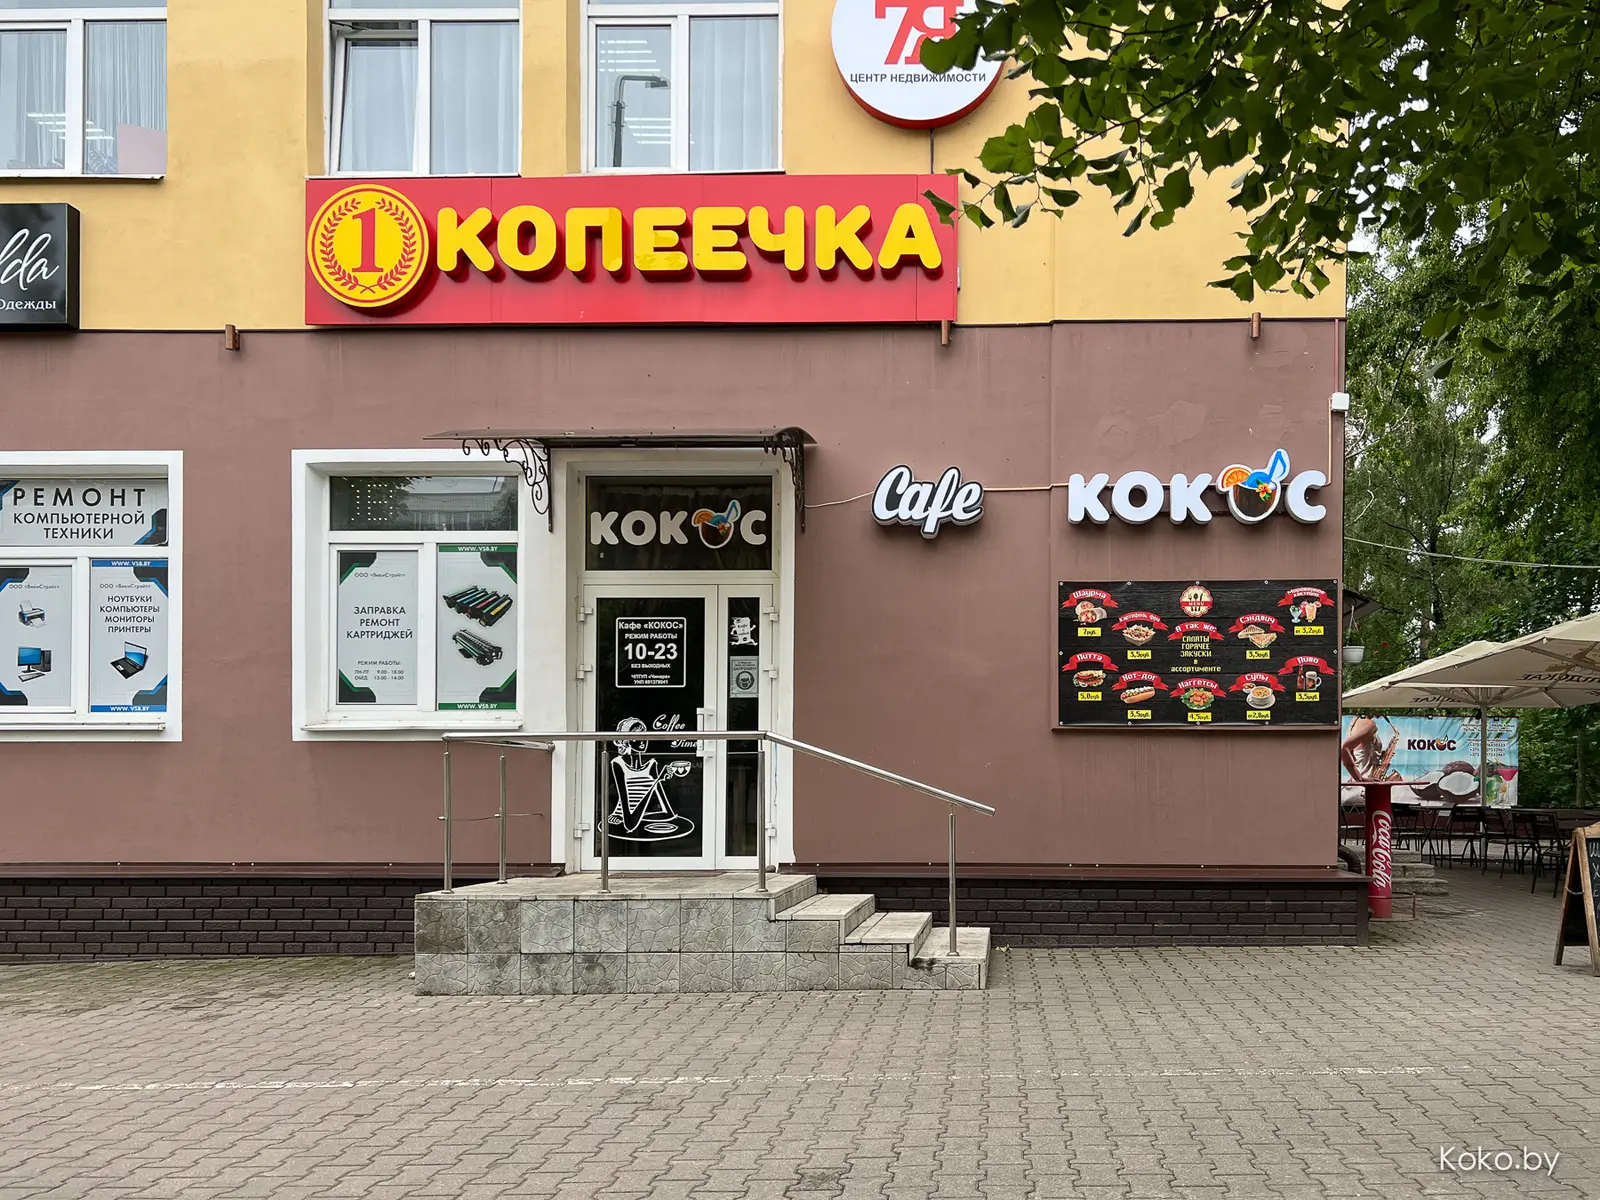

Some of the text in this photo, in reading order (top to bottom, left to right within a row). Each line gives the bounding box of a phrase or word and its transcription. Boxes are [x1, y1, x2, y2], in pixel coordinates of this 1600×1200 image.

[850, 74, 986, 84] ЦЕНТР НЕДВИЖИМОСТИ
[436, 203, 943, 273] КОПЕЕЧКА
[13, 487, 146, 507] РЕМОНТ
[872, 465, 985, 538] Cafe
[13, 510, 145, 525] КОМПЬЮТЕРНОЙ
[44, 527, 114, 540] ТЕХНИКИ
[107, 595, 153, 603] НОУТБУКИ
[1072, 589, 1108, 600] Шаурма
[99, 605, 160, 614] КОМПЬЮТЕРЫ
[353, 606, 407, 615] ЗАПРАВКА
[104, 615, 155, 624] МОНИТОРЫ
[359, 618, 400, 627] РЕМОНТ
[1239, 615, 1276, 625] Сэндвич
[107, 625, 152, 634] ПРИНТЕРЫ
[618, 621, 684, 631] Кафе «КОКОС»
[346, 629, 413, 640] КАРТРИДЖЕЙ
[624, 642, 678, 660] 10-23
[1297, 656, 1320, 664] Пиво
[1245, 673, 1269, 682] Супы
[653, 714, 686, 731] Coffee
